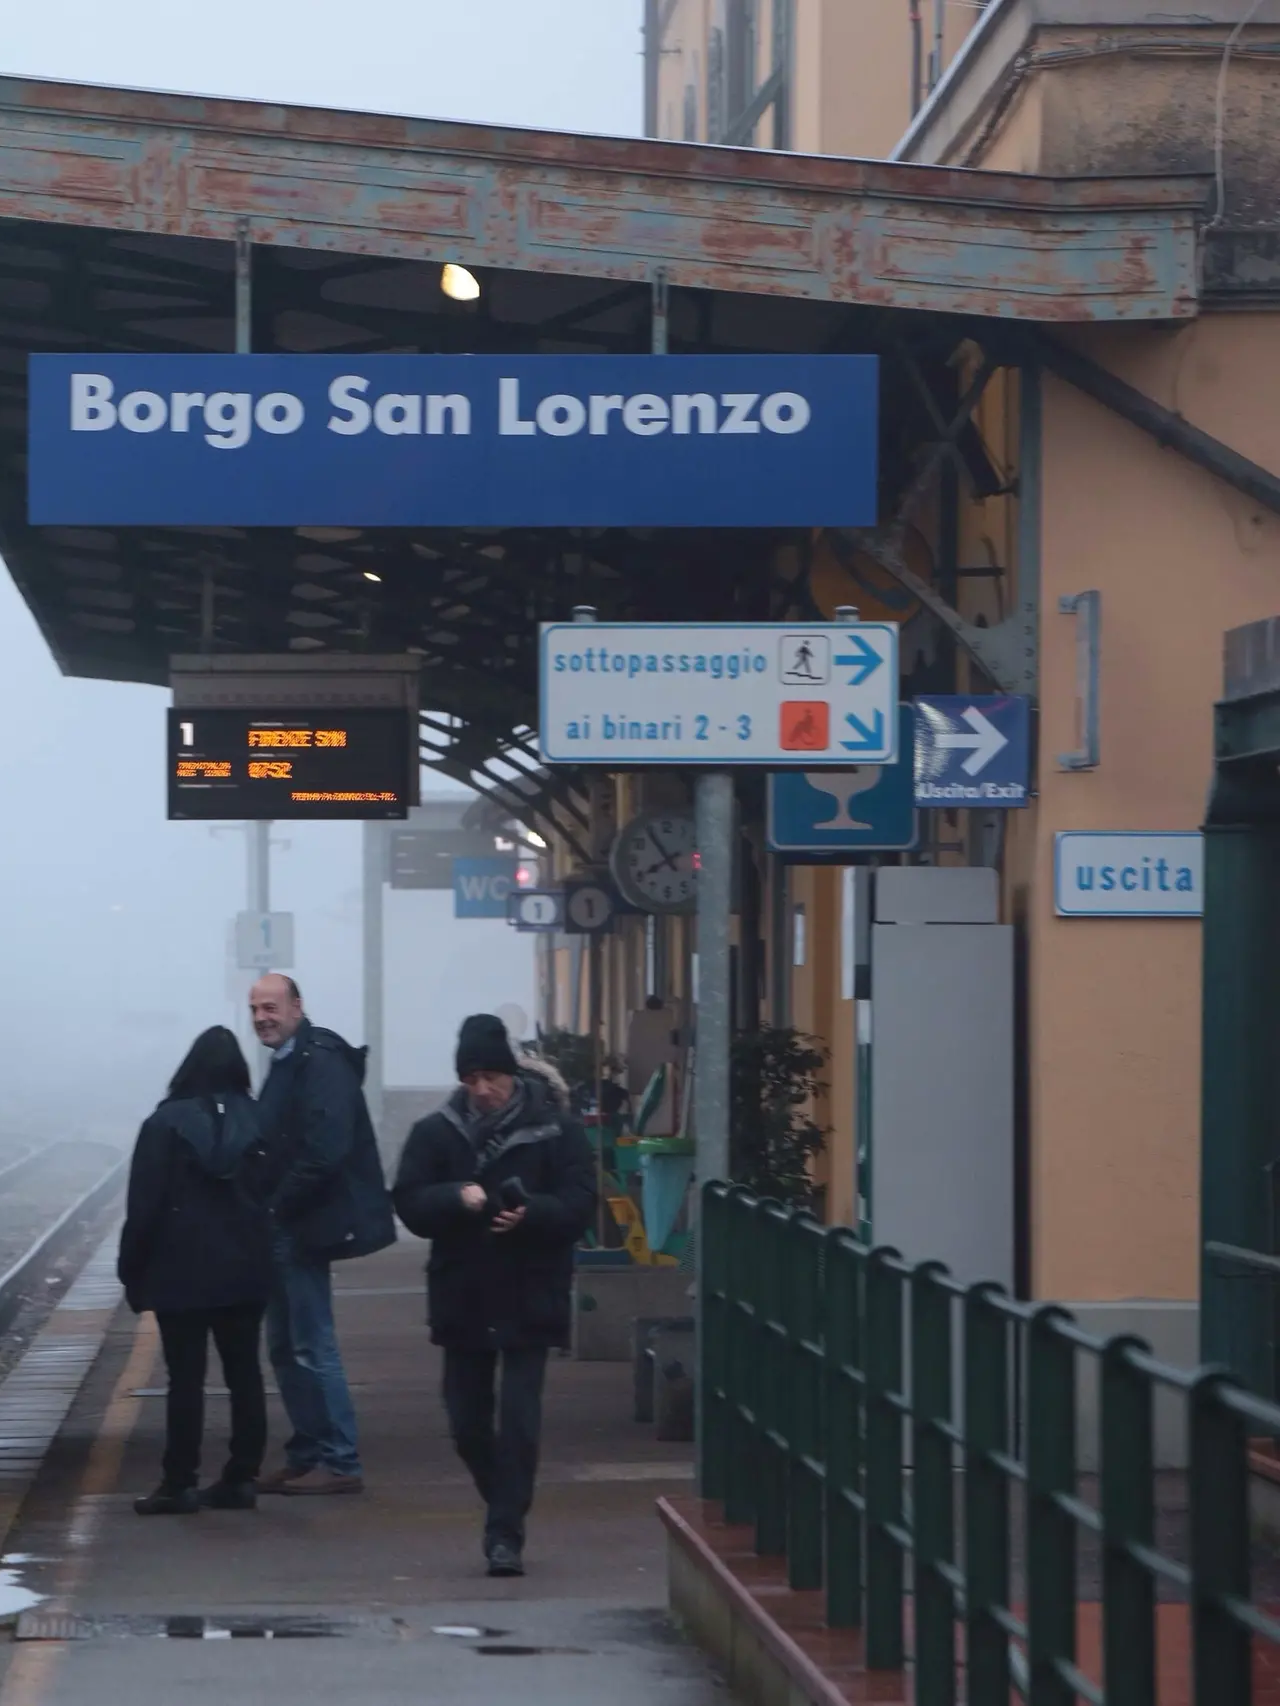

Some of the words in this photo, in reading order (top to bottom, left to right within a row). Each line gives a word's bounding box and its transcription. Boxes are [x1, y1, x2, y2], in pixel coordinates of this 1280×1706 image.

[70, 373, 304, 448] Borgo
[326, 374, 471, 437] San
[498, 377, 812, 438] Lorenzo
[554, 648, 768, 678] sottopassaggio
[179, 722, 195, 746] 1
[566, 715, 590, 740] ai
[602, 715, 682, 740] binari
[1076, 856, 1193, 891] uscita
[458, 875, 513, 901] WC
